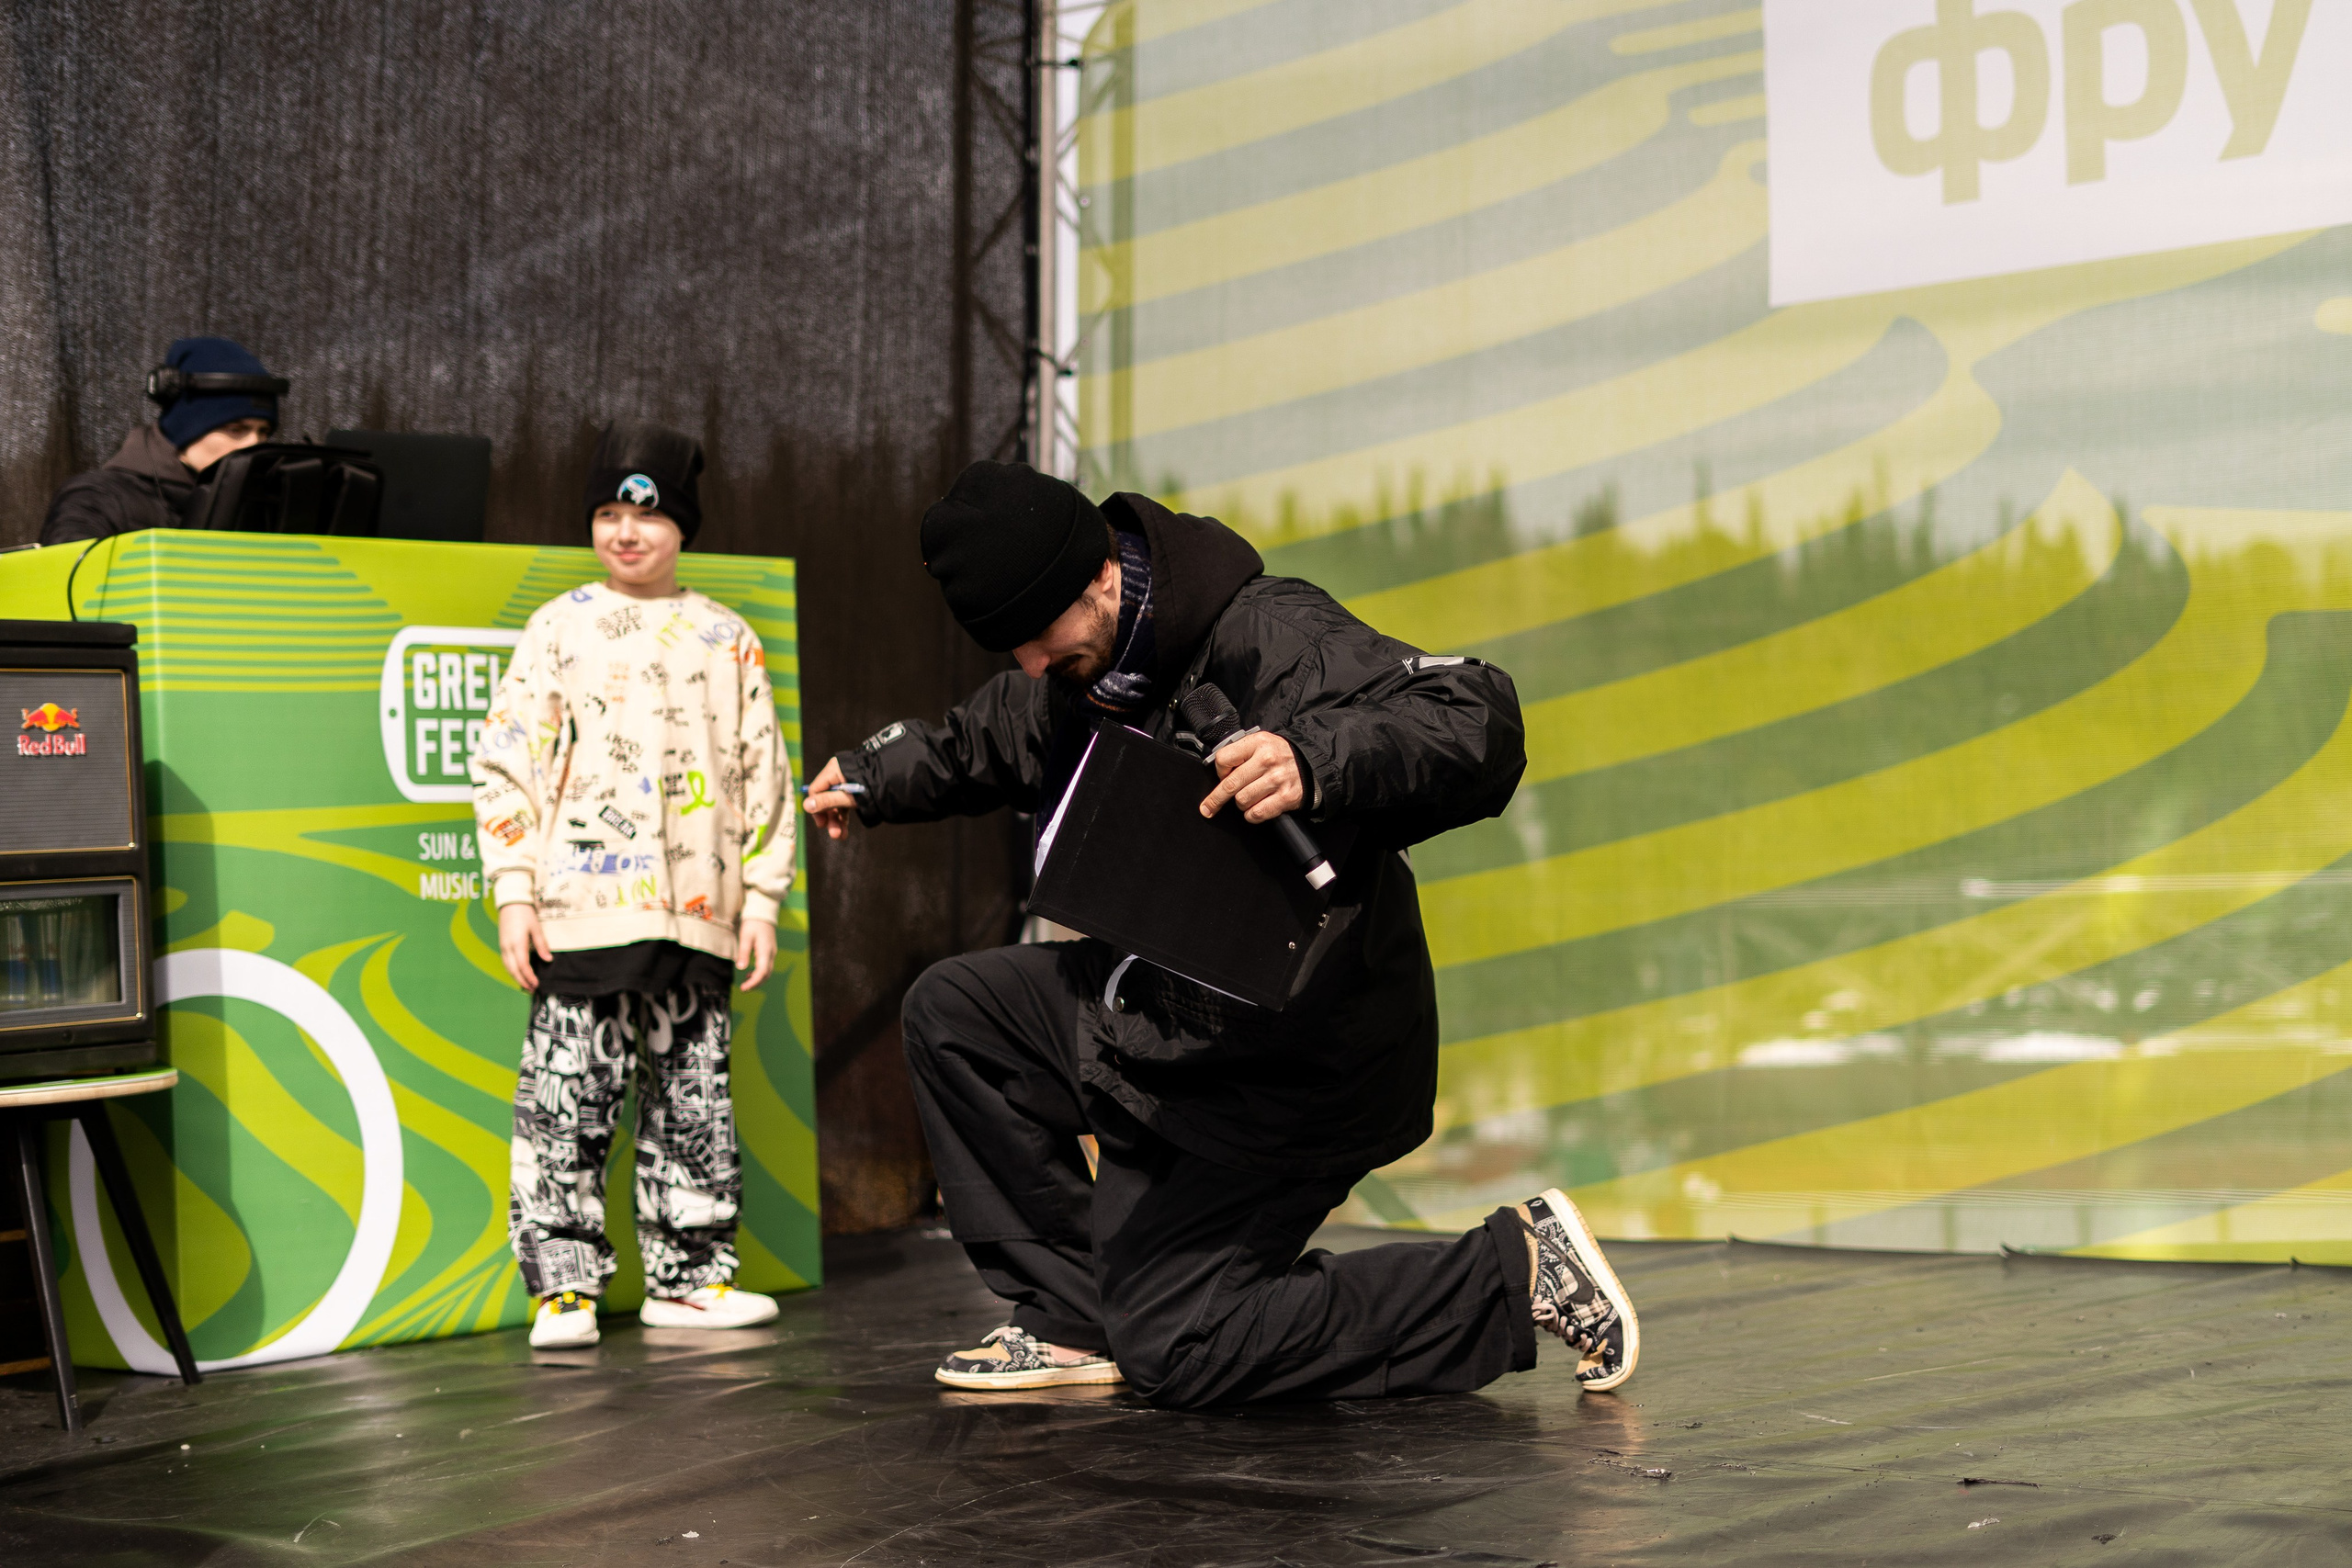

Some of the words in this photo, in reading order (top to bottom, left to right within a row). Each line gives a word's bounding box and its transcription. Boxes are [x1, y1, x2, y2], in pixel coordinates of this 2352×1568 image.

[17, 733, 52, 756] Red
[52, 733, 86, 756] Bull
[419, 832, 458, 860] SUN
[461, 833, 476, 860] &
[420, 872, 481, 900] MUSIC
